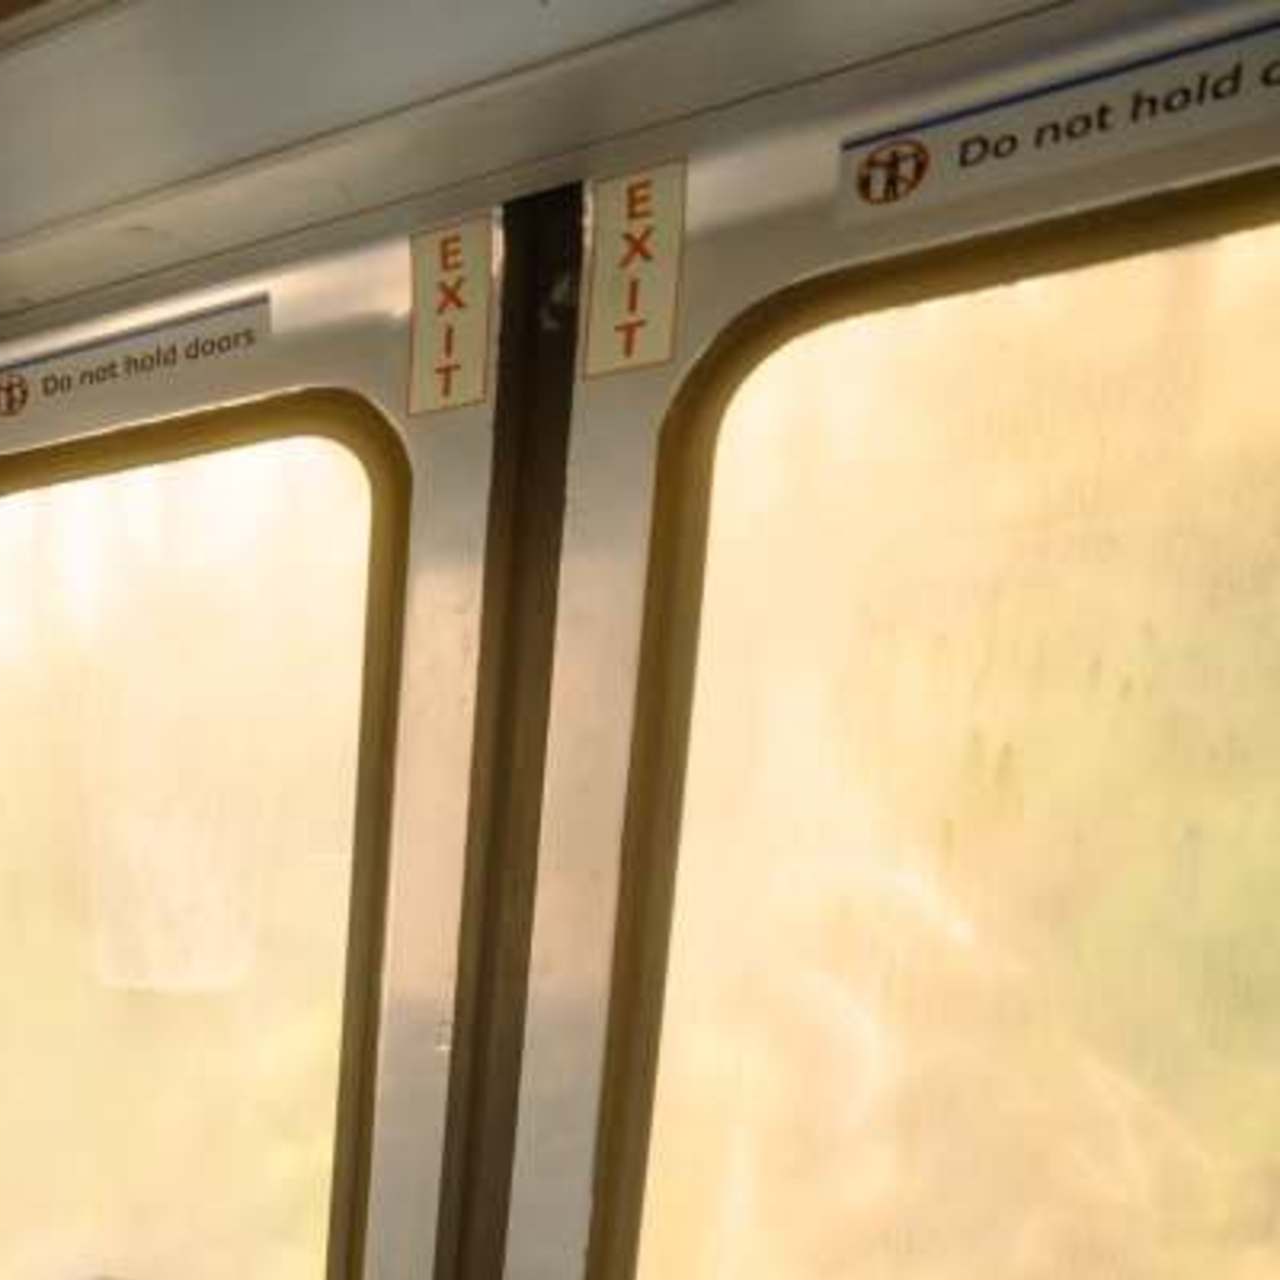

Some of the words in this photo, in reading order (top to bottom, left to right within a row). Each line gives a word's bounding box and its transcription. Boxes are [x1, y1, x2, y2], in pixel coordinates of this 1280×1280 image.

[957, 135, 1018, 168] Do
[1033, 102, 1114, 149] not
[1130, 60, 1243, 124] hold
[435, 235, 466, 398] EXIT
[614, 178, 654, 359] EXIT
[42, 372, 72, 397] Do
[79, 361, 119, 386] not
[125, 344, 178, 376] hold
[184, 327, 256, 360] doors
